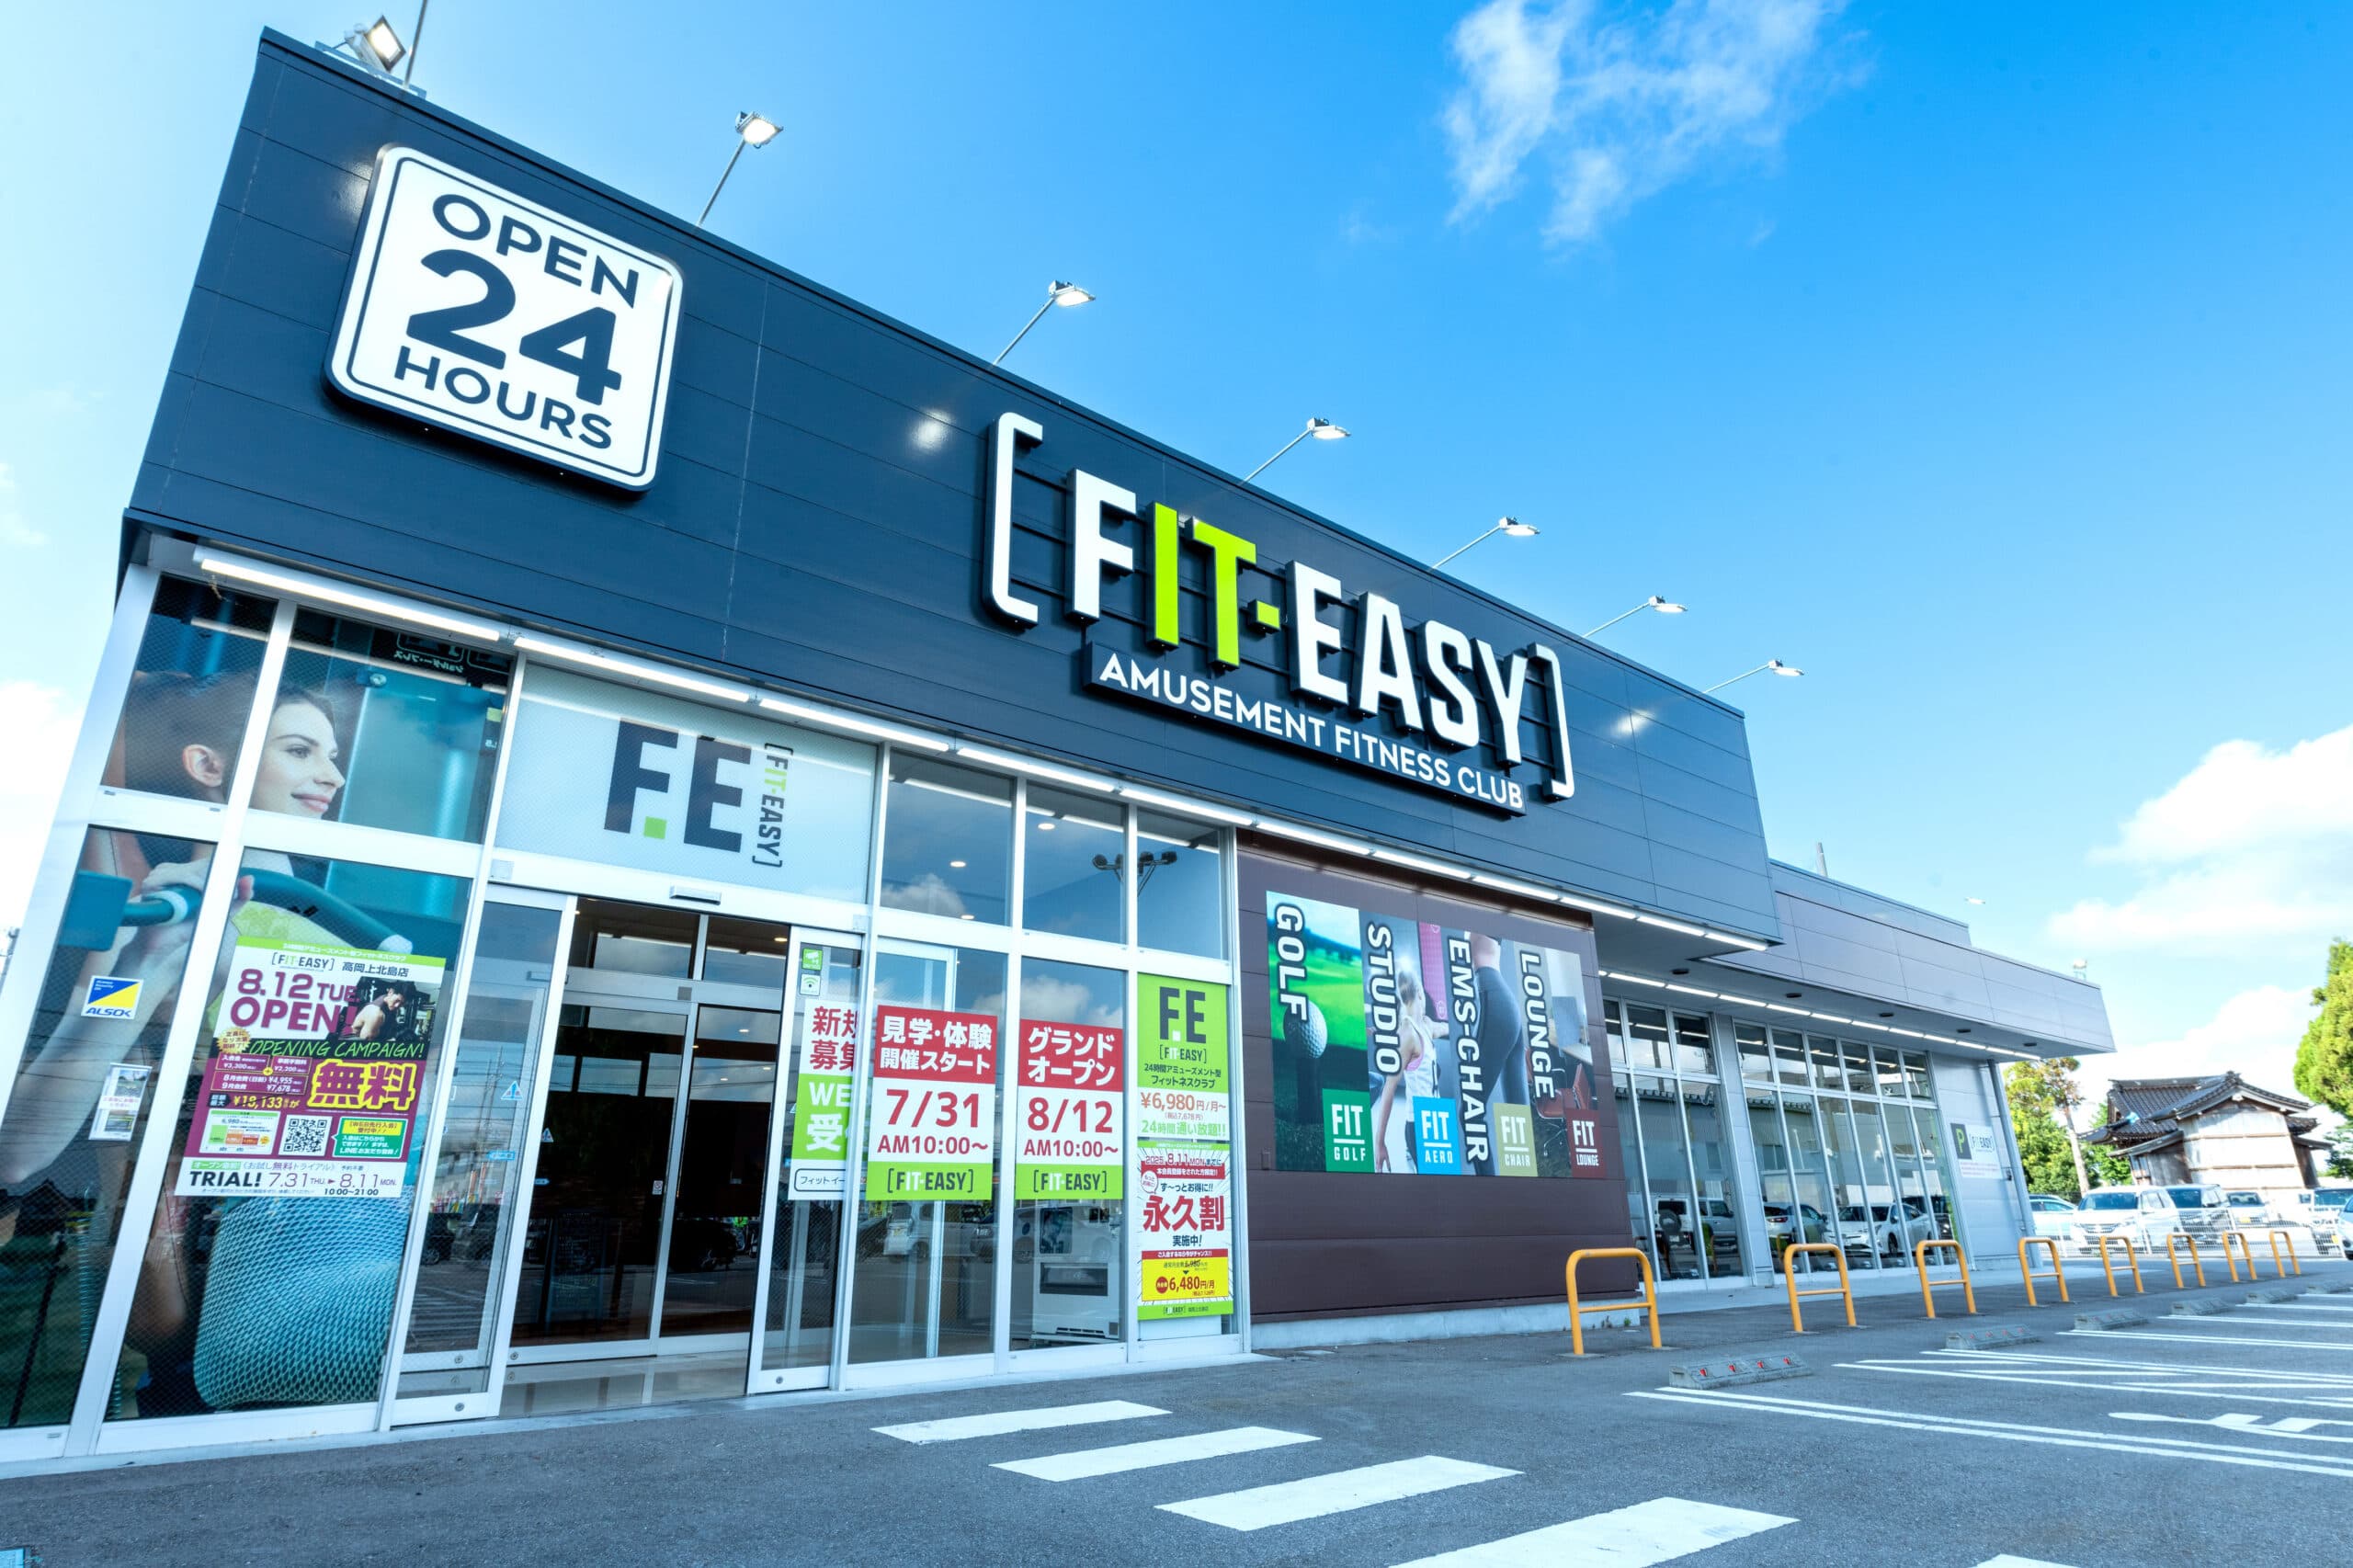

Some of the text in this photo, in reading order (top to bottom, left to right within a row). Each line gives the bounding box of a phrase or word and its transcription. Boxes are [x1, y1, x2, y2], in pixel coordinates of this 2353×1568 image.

[432, 193, 640, 311] OPEN
[405, 248, 622, 406] 24
[393, 345, 613, 451] HOURS
[1099, 652, 1525, 810] AMUSEMENT FITNESS CLUB
[1274, 903, 1309, 1025] GOLF
[237, 968, 314, 1000] 8.12
[1366, 921, 1403, 1075] STUDIO
[881, 1016, 993, 1051] 見学・体験
[1518, 950, 1556, 1100] LOUNGE
[249, 1040, 425, 1058] OPENING CAMPAIGN!
[1028, 1026, 1116, 1059] グランド
[1447, 935, 1490, 1163] EMS-CHAIR
[880, 1047, 991, 1075] 開催スタート
[1028, 1055, 1116, 1086] オープン
[1144, 1062, 1222, 1078] 24時間アミューズメント型
[307, 1058, 417, 1111] 無料
[1151, 1074, 1216, 1089] フィットネスクラブ
[886, 1088, 980, 1129] 7/31
[1028, 1096, 1113, 1133] 8/12
[1331, 1104, 1364, 1137] FIT
[1421, 1108, 1450, 1142] FIT
[806, 1113, 850, 1153] 受
[1500, 1114, 1527, 1143] FIT
[1572, 1119, 1596, 1146] FIT
[1955, 1128, 1966, 1154] P
[1334, 1146, 1367, 1163] GOLF
[1425, 1149, 1454, 1165] AERO
[1504, 1152, 1531, 1167] CHAIR
[1575, 1153, 1600, 1167] LOUNGE
[189, 1171, 262, 1187] TRIAL!
[268, 1172, 308, 1187] 7.31
[339, 1173, 380, 1188] 8.11
[1142, 1195, 1225, 1233] 永久割
[1172, 1234, 1203, 1247] 実施中!
